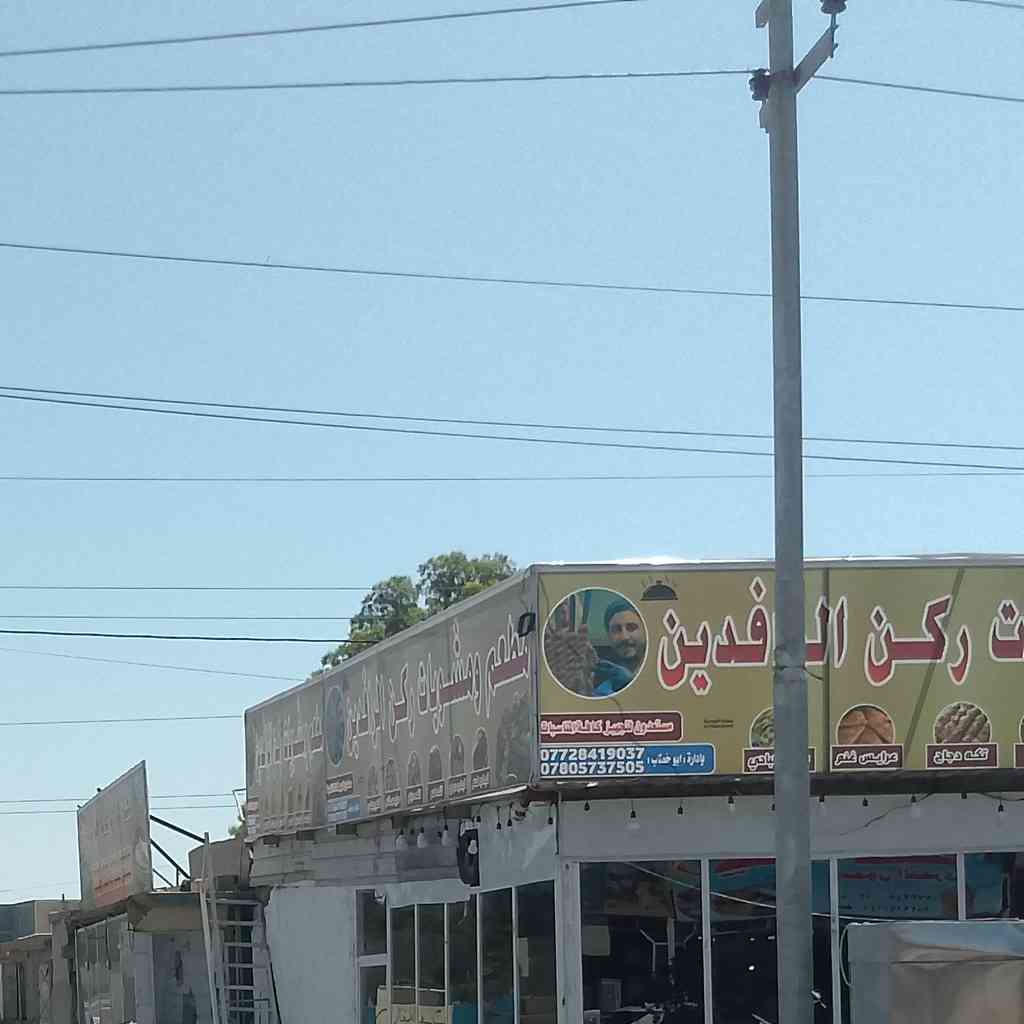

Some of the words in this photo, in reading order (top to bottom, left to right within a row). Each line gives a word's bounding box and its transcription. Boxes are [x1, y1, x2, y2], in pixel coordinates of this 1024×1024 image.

[657, 576, 848, 695] الفدين
[864, 594, 971, 686] ركن
[540, 748, 645, 761] 07728419037
[858, 750, 898, 766] عرايس
[933, 749, 963, 764] دجاج
[540, 761, 644, 775] 07805737505
